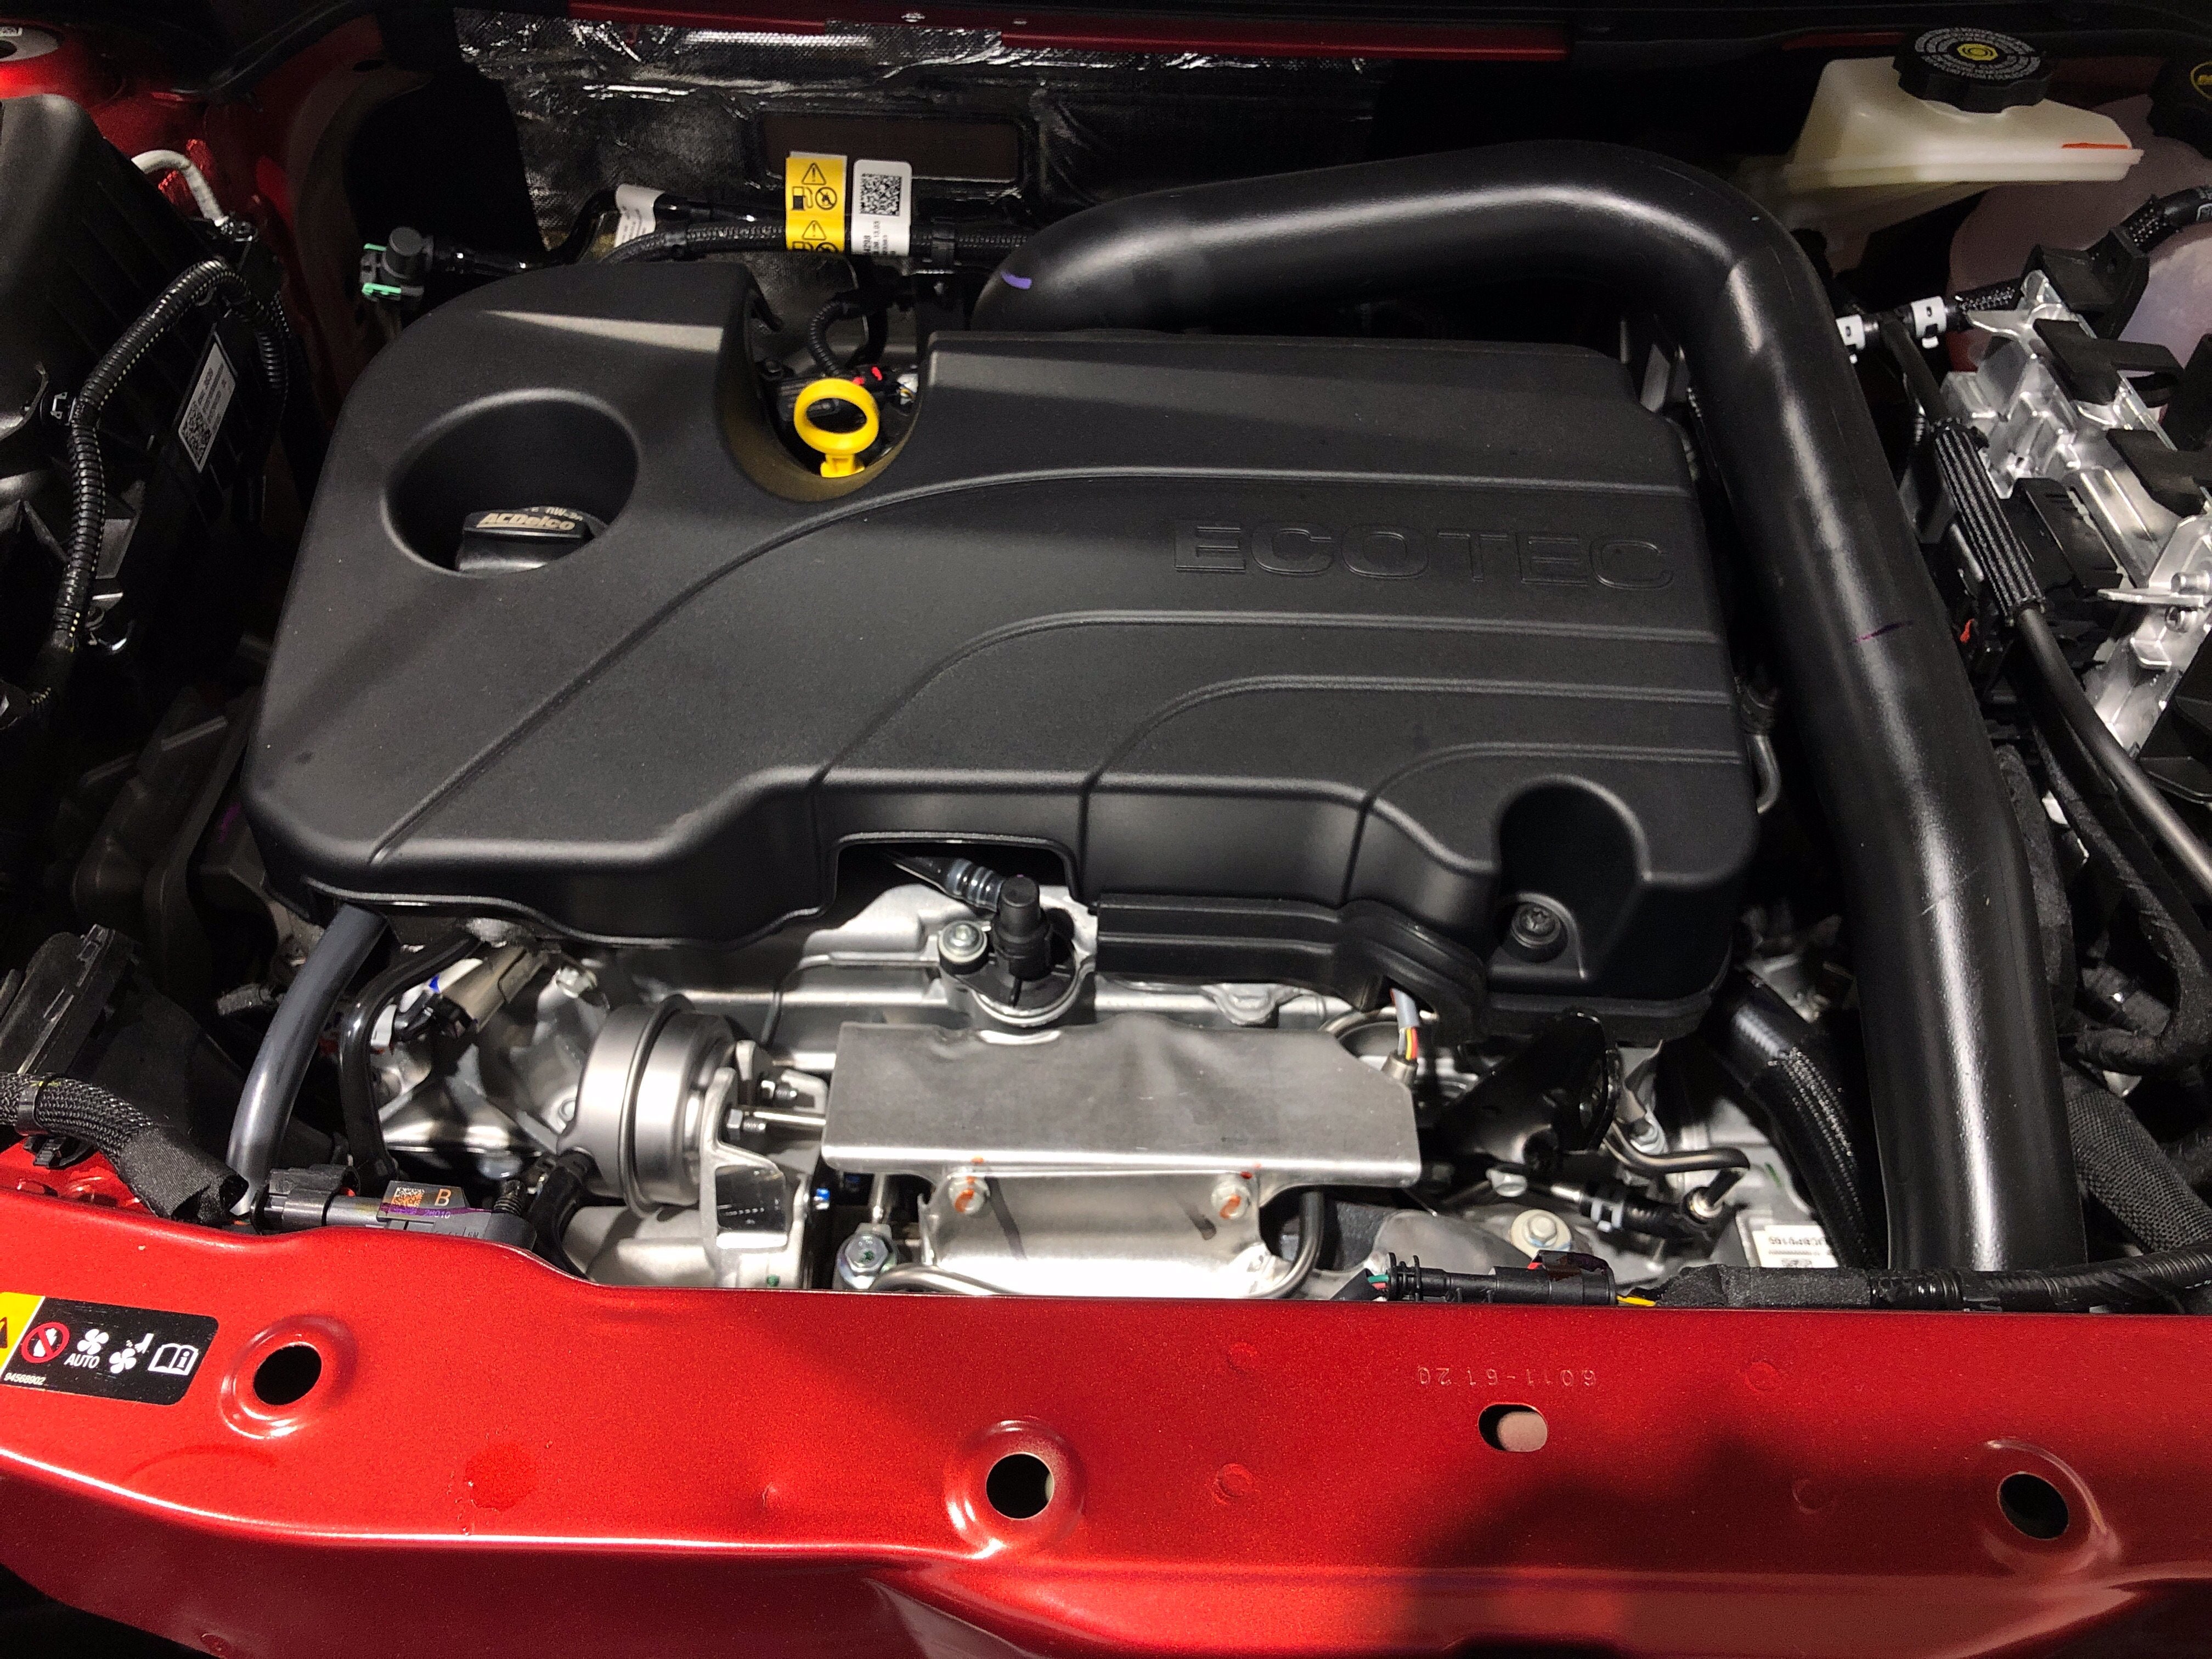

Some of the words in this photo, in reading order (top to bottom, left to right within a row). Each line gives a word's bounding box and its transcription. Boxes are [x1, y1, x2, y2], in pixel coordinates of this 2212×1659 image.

[476, 512, 575, 531] ACDelco
[1174, 522, 1674, 590] ECOTEC
[434, 1188, 452, 1206] B
[64, 1353, 100, 1369] AUTO
[3, 1372, 46, 1386] 94568902
